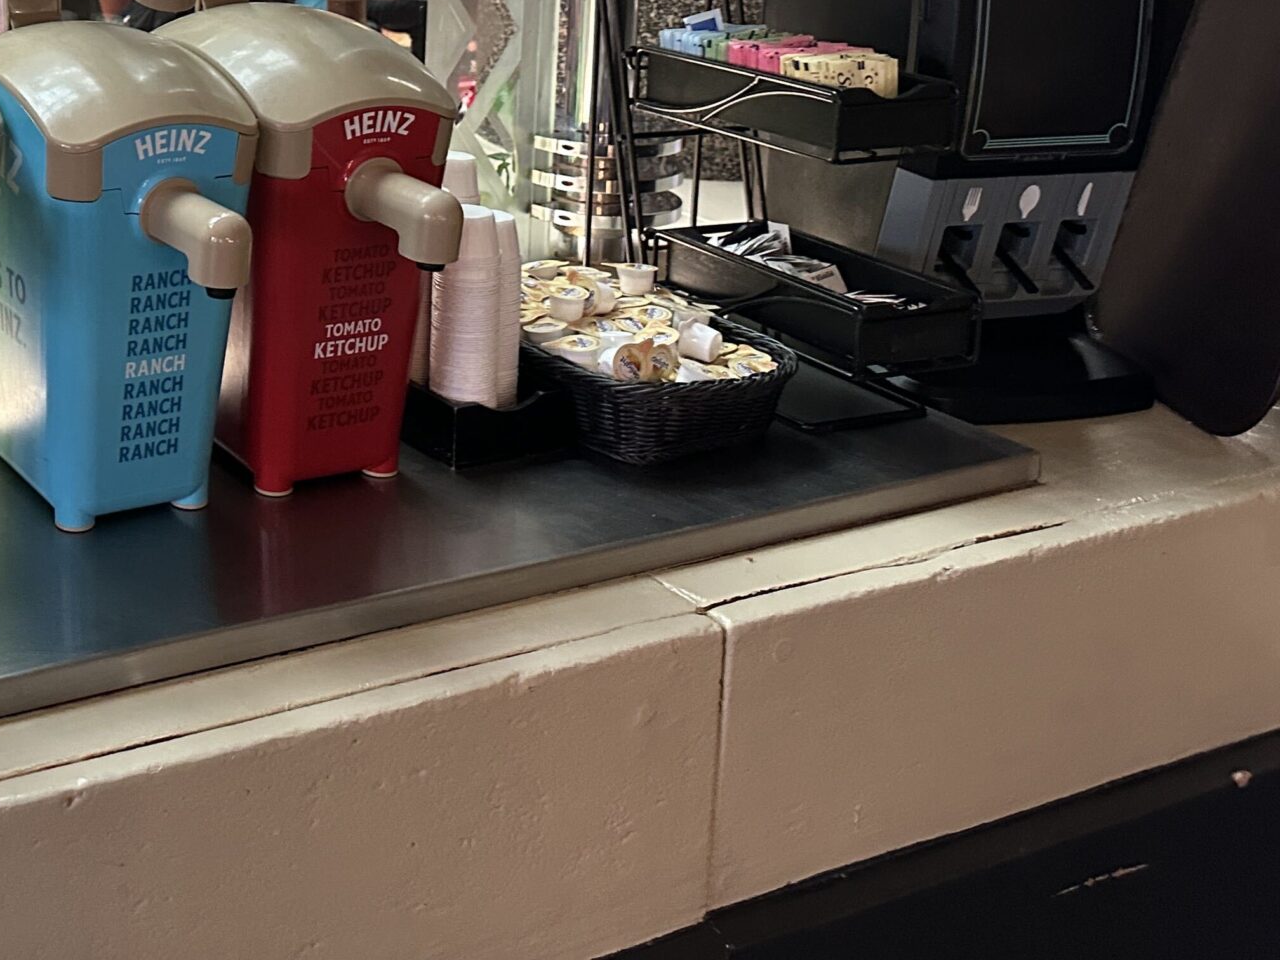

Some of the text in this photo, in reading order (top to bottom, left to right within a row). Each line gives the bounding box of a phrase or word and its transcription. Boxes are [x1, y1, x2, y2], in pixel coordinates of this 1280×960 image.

[344, 110, 416, 140] HEINZ
[134, 128, 212, 160] HEINZ
[334, 244, 390, 262] TOMATO
[131, 269, 192, 293] RANCH
[321, 260, 397, 285] KETCHUP
[6, 266, 26, 305] TO
[328, 281, 385, 301] TOMATO
[130, 290, 191, 314] RANCH
[318, 297, 393, 322] KETCHUP
[128, 311, 189, 336] RANCH
[325, 318, 382, 338] TOMATO
[126, 333, 188, 358] RANCH
[313, 334, 389, 359] KETCHUP
[124, 353, 186, 379] RANCH
[321, 355, 377, 375] TOMATO
[123, 374, 184, 400] RANCH
[310, 369, 384, 396] KETCHUP
[122, 396, 182, 421] RANCH
[318, 390, 374, 411] TOMATO
[120, 416, 180, 442] RANCH
[305, 405, 380, 432] KETCHUP
[118, 437, 178, 463] RANCH
